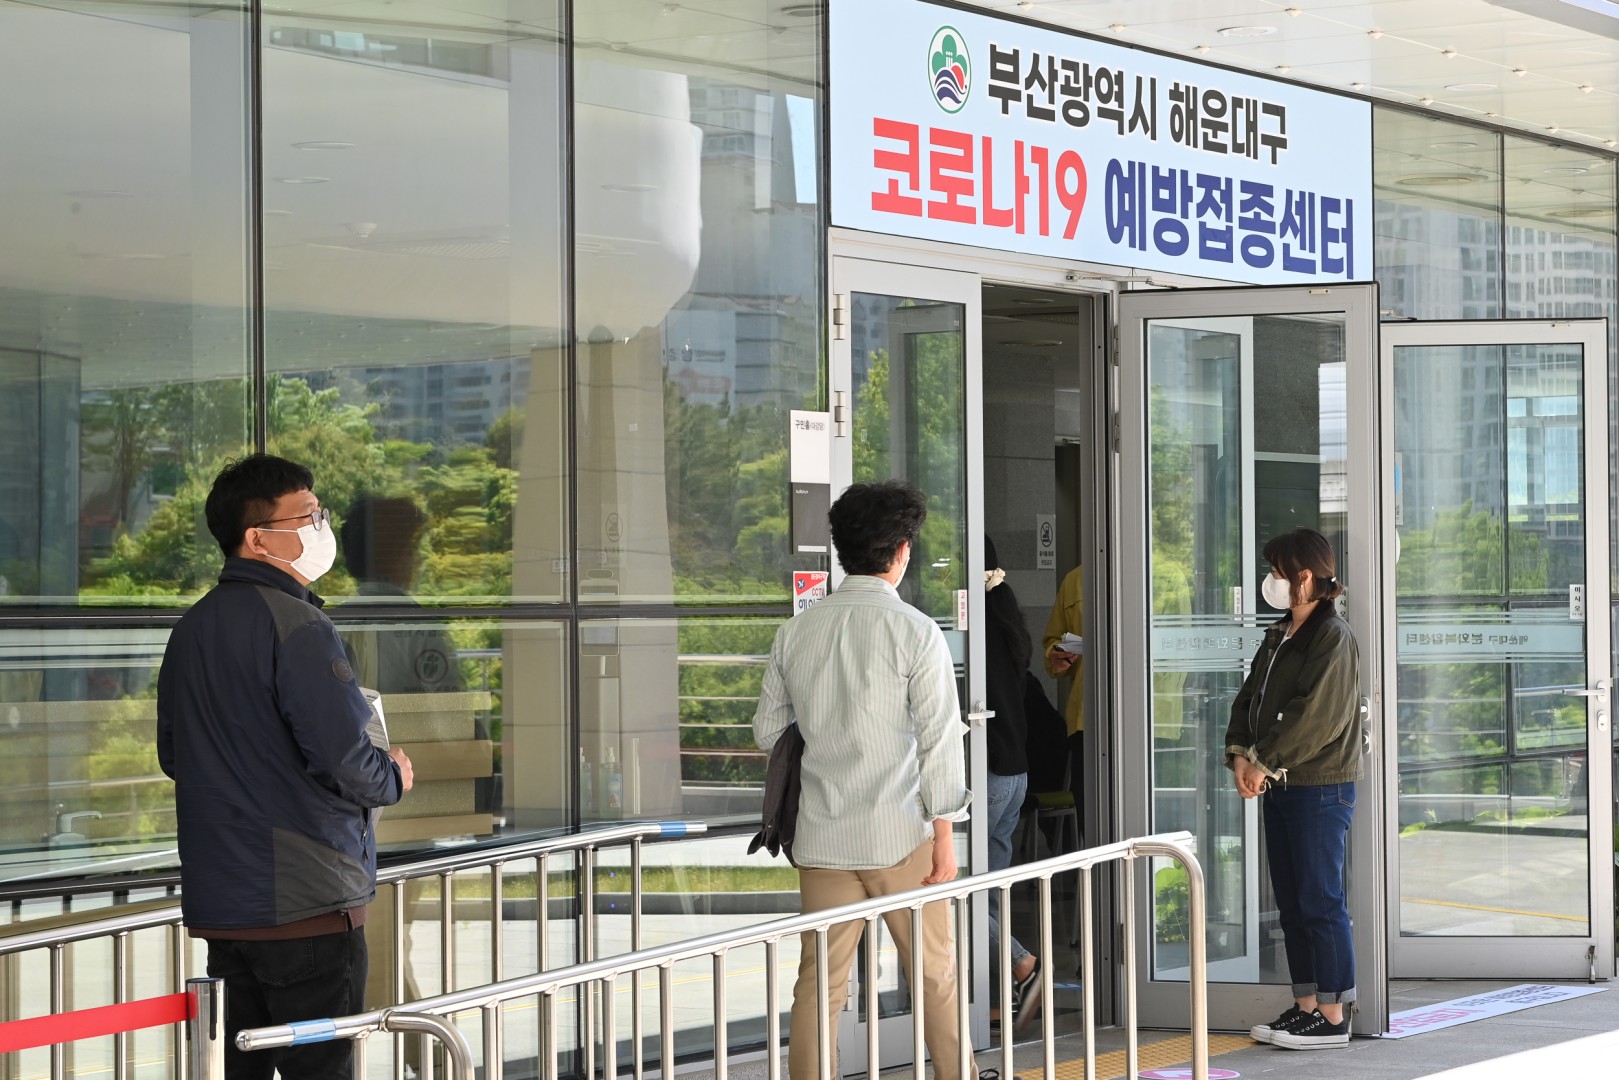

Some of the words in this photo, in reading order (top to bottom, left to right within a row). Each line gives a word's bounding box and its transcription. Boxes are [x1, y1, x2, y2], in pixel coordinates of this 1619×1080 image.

[987, 43, 1157, 142] 부산광역시
[1168, 80, 1289, 166] 해운대구
[870, 116, 1088, 241] 코로나19
[1104, 158, 1355, 280] 예방접종센터
